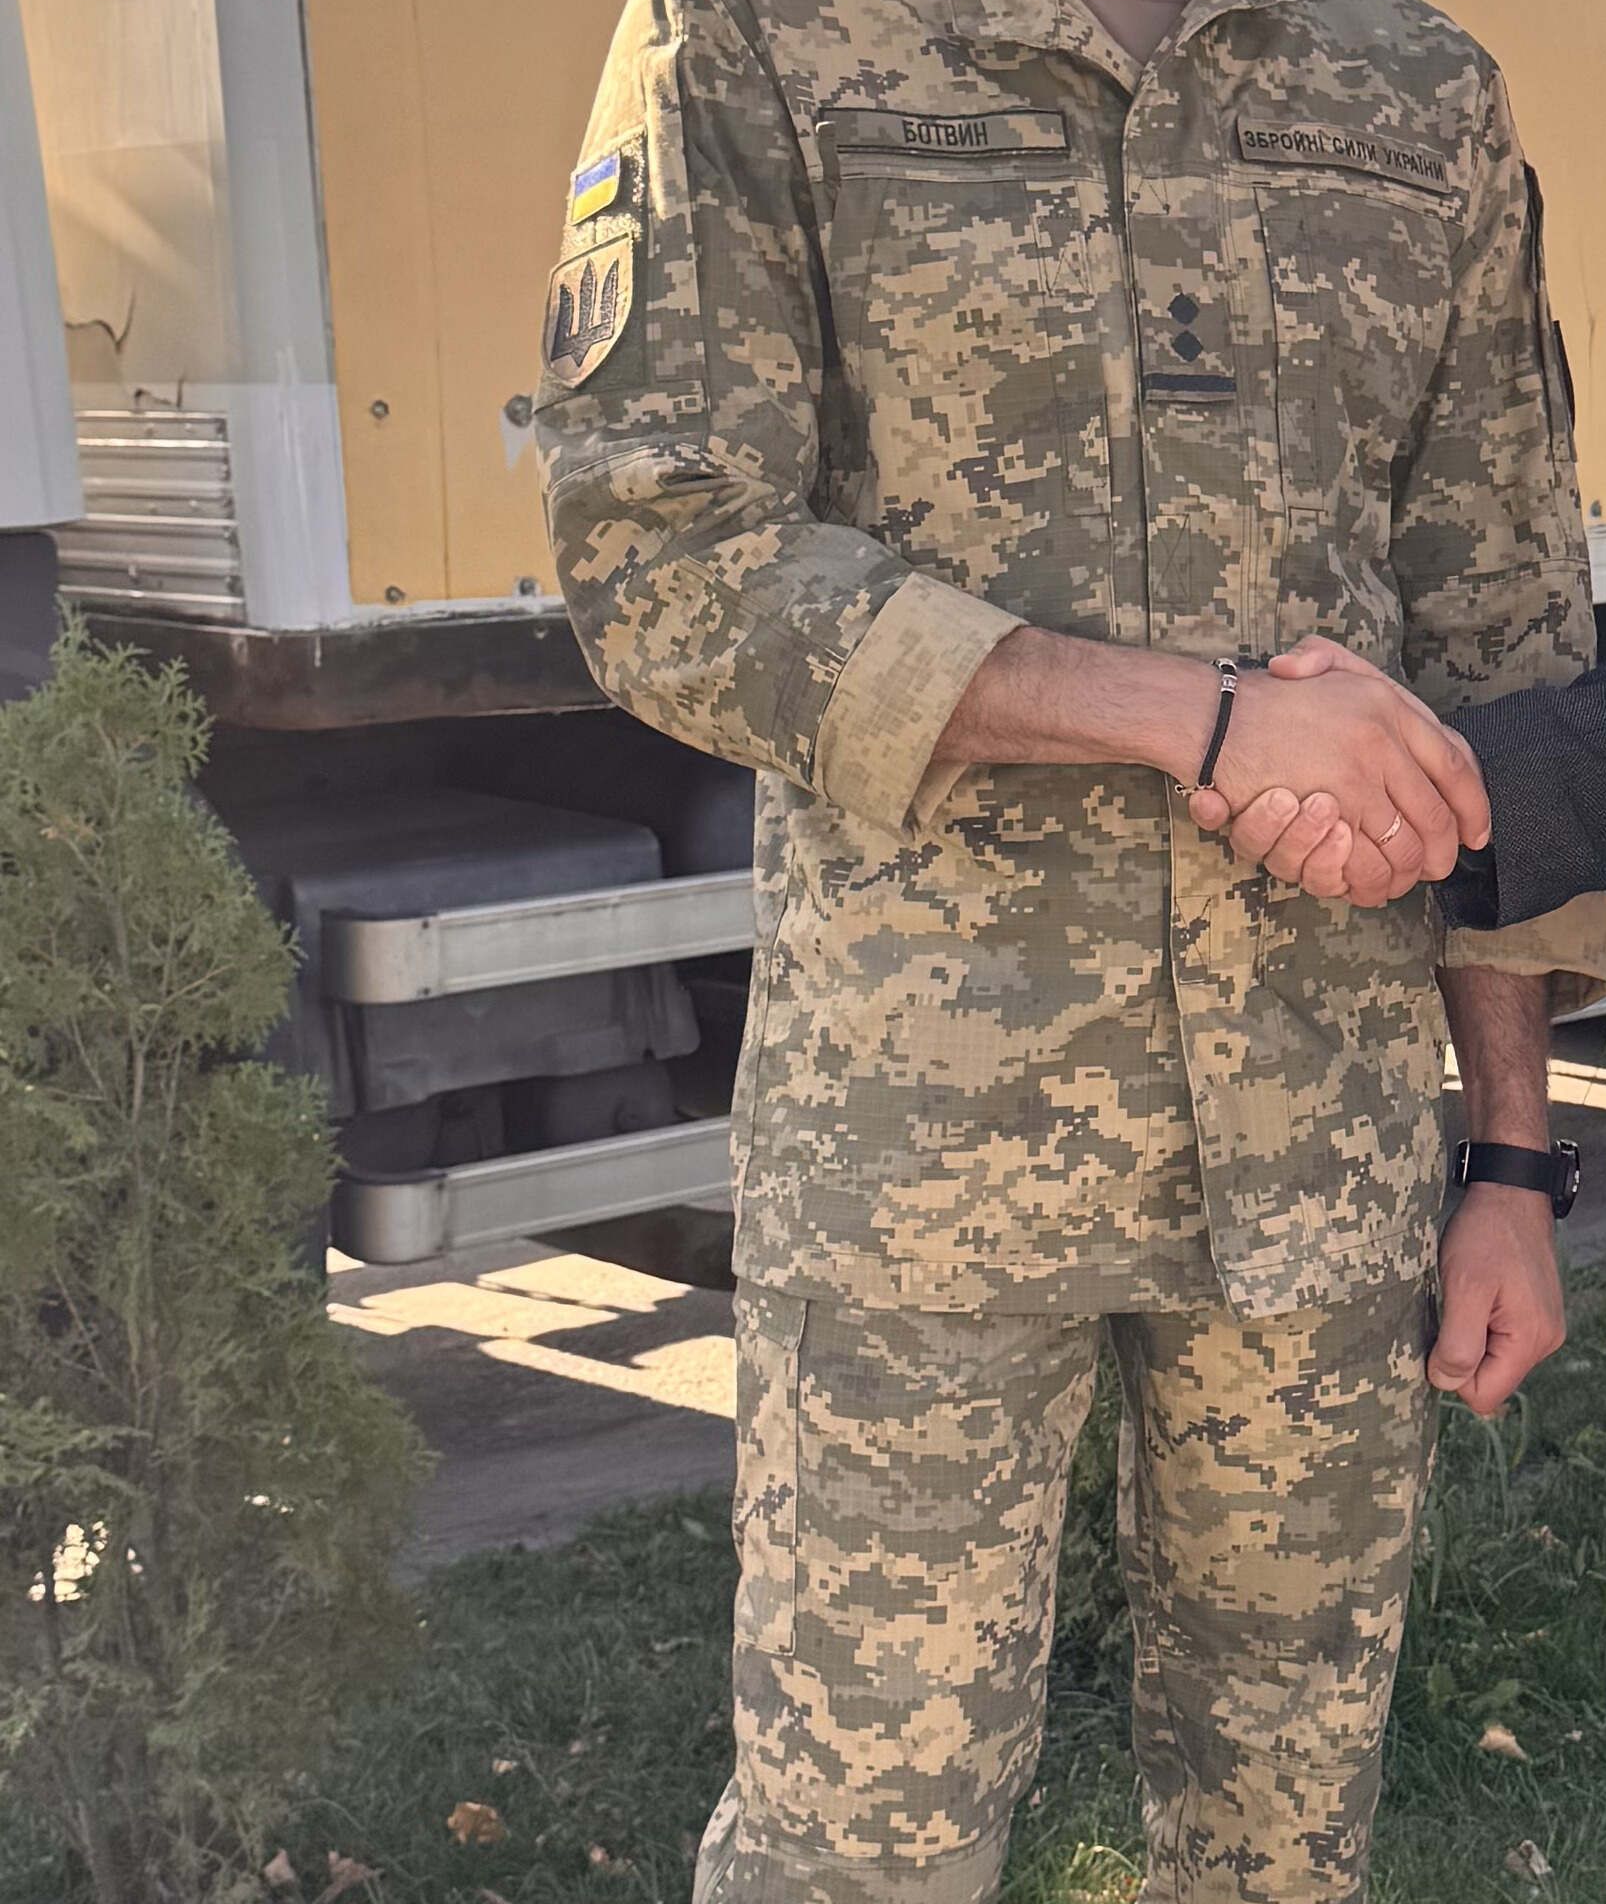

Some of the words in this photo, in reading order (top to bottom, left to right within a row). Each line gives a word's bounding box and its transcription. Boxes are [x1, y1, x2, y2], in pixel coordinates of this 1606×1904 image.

[902, 119, 989, 147] БОТВИН
[1243, 129, 1325, 153] ЗБРОЙНІ
[1333, 136, 1377, 162] СИЛИ
[1383, 146, 1445, 182] УКРАЇНИ
